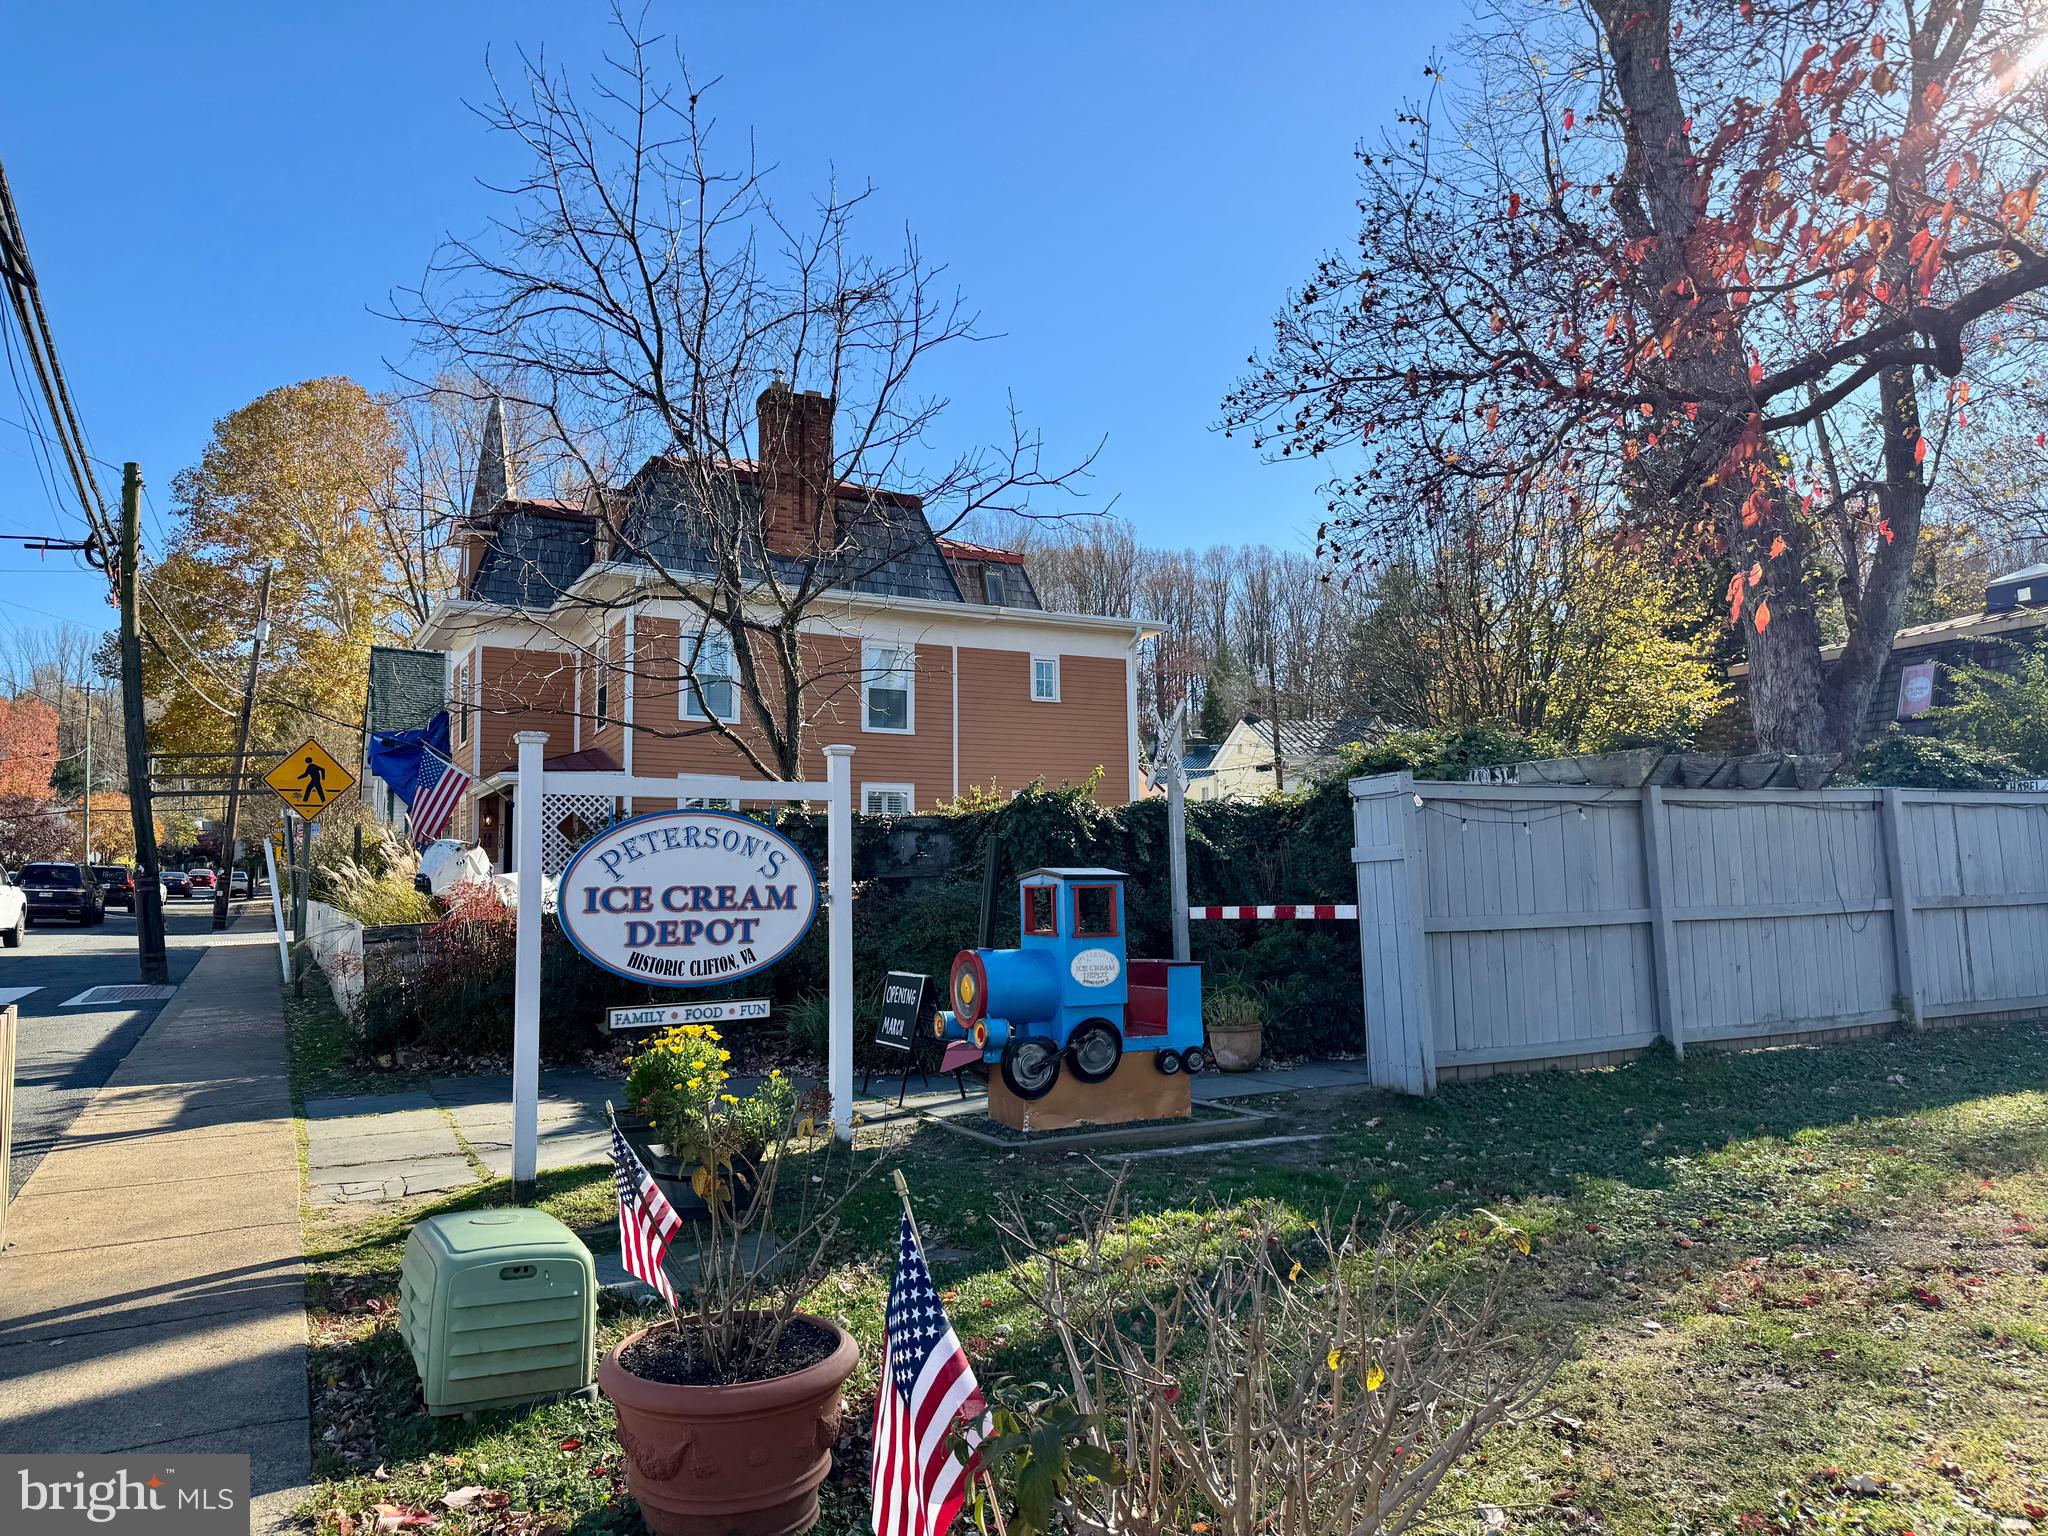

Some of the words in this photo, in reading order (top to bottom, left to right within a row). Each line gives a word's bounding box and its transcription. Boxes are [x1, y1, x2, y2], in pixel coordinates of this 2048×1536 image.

[594, 825, 789, 882] PETERSON'S
[582, 885, 654, 914] ICE
[661, 884, 797, 913] CREAM
[624, 917, 760, 948] DEPOT
[627, 951, 685, 976] HISTORIC
[690, 954, 740, 976] CLIFTON,
[740, 947, 757, 964] VA
[886, 985, 917, 1005] OPENING
[614, 1010, 666, 1025] FAMILY
[684, 1006, 723, 1020] FOOD
[739, 1003, 767, 1016] FUN
